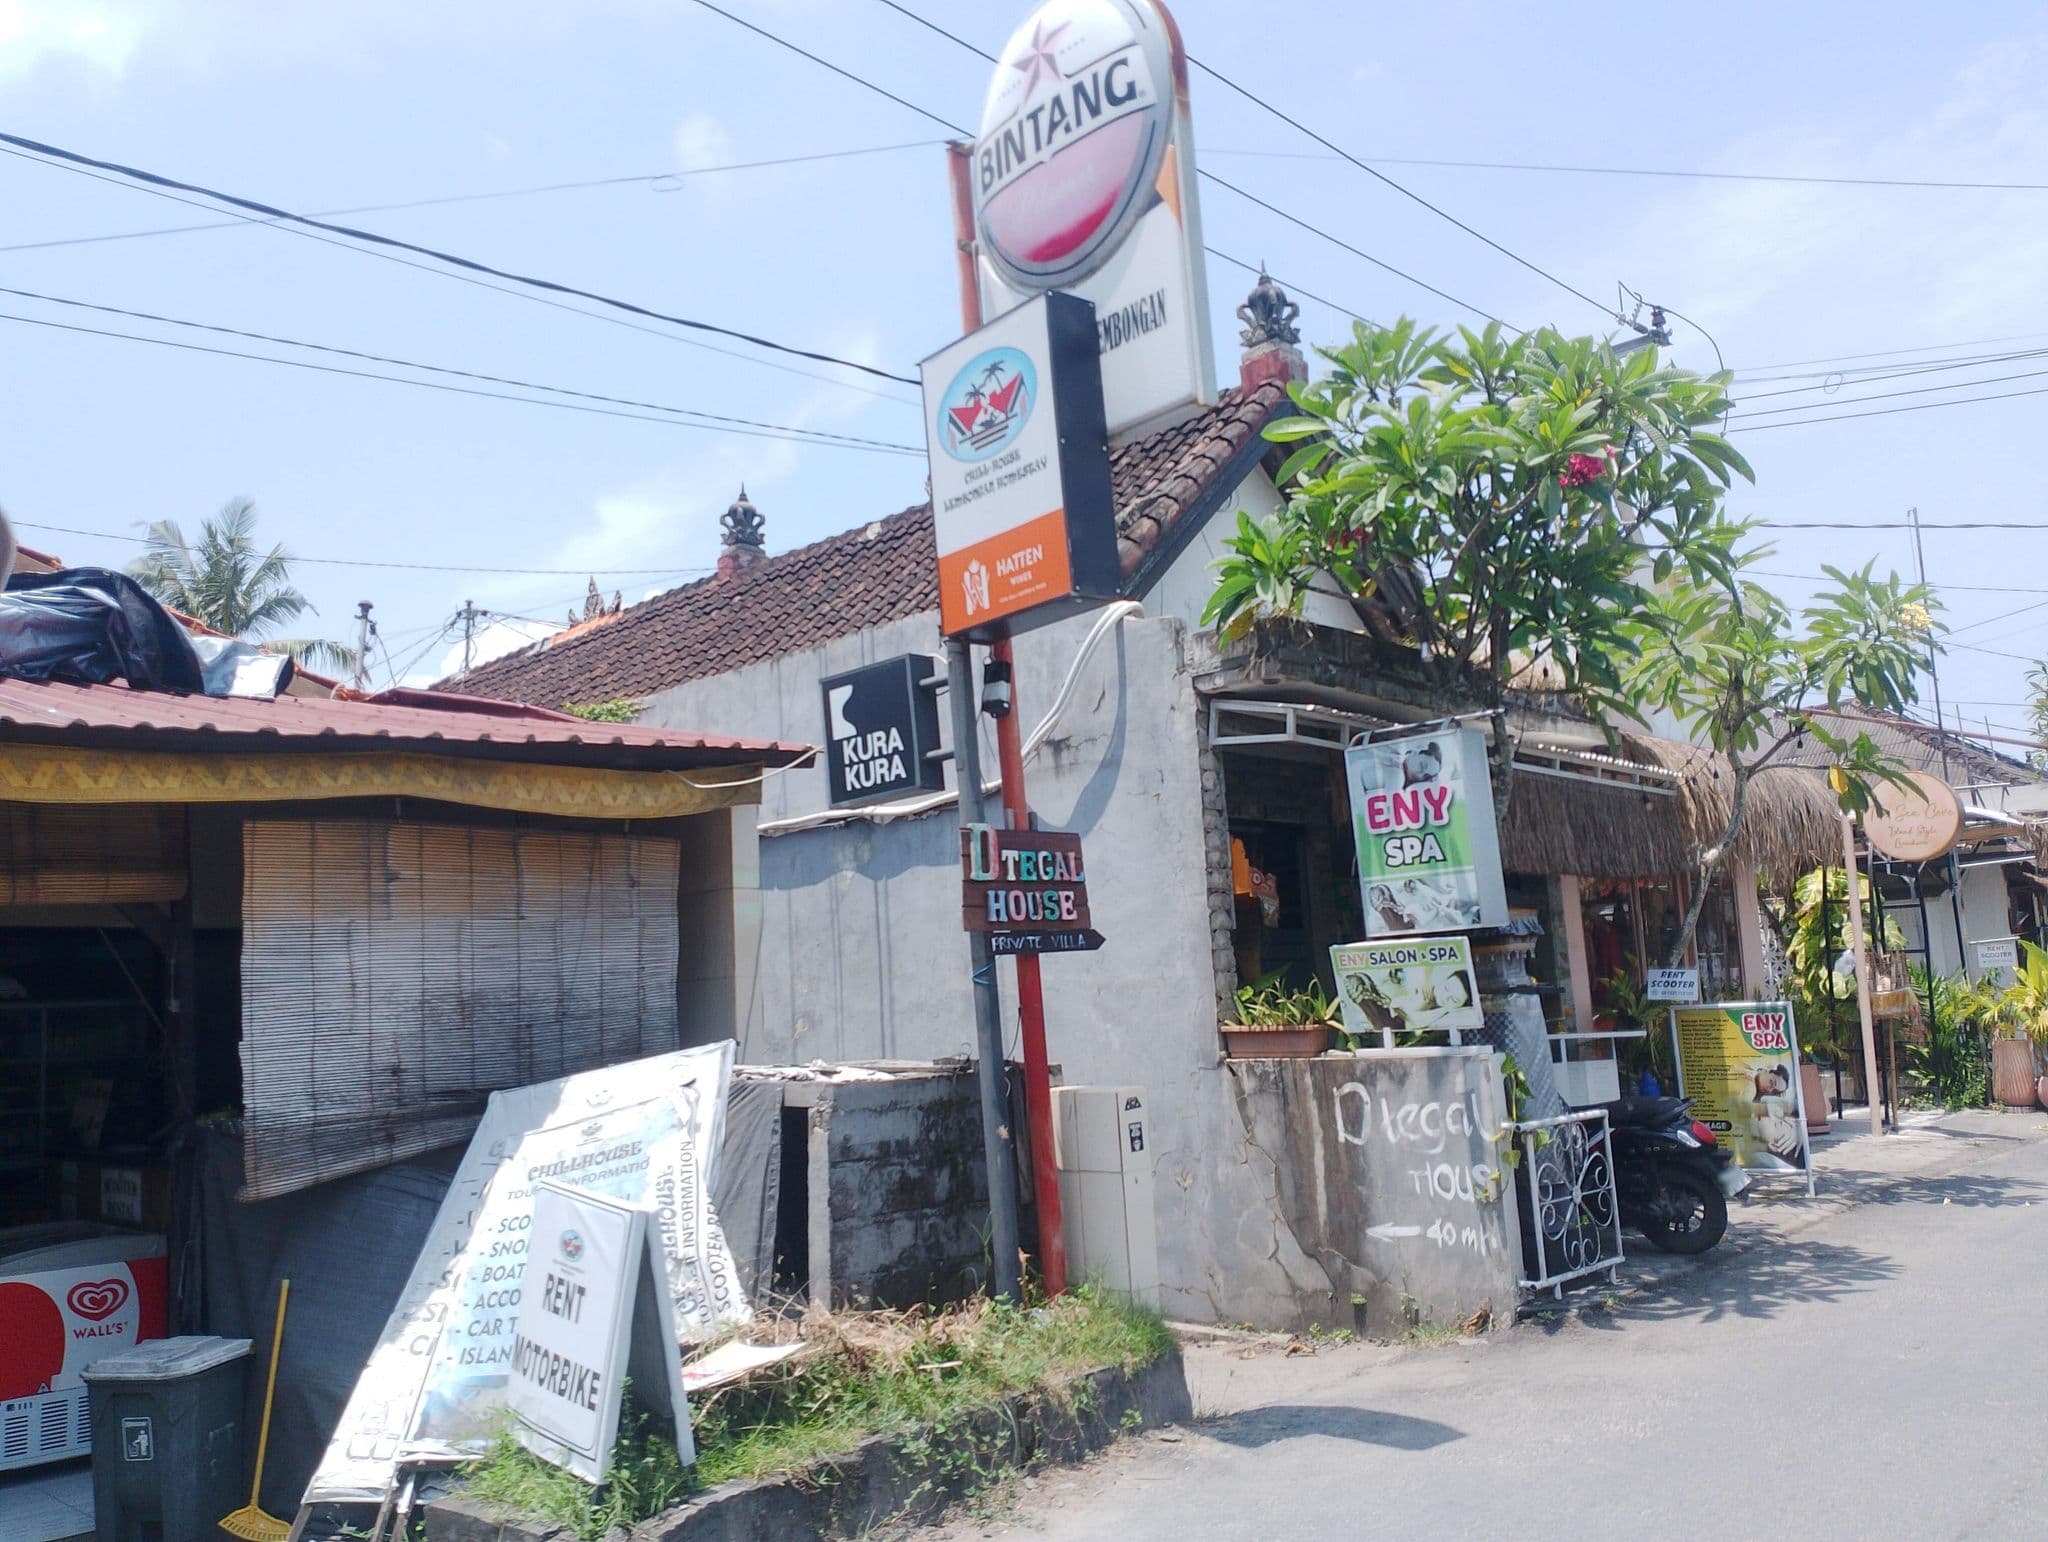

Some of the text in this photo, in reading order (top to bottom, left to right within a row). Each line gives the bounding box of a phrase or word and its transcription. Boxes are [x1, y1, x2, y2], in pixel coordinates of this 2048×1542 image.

[981, 57, 1138, 194] BINTANG
[996, 543, 1043, 577] HATTEN
[843, 727, 904, 765] KURA
[845, 754, 907, 792] KURA
[1366, 785, 1450, 831] ENY
[1384, 833, 1446, 867] SPA
[987, 889, 1078, 922] HOUSE
[1051, 933, 1087, 948] VILLA
[1340, 953, 1366, 968] ENY
[1369, 949, 1417, 965] SALON
[1429, 947, 1459, 961] SPA
[1650, 980, 1695, 989] SCOOTER
[1661, 971, 1686, 980] RENT
[1743, 1013, 1785, 1032] ENY
[1754, 1032, 1787, 1047] SPA
[680, 1140, 695, 1248] INFORMATION
[489, 1238, 529, 1258] SNO
[1426, 1217, 1457, 1249] 40
[481, 1262, 527, 1283] BOAT
[542, 1272, 587, 1325] RENT
[73, 1322, 123, 1339] WALL'S
[467, 1318, 503, 1338] CAR
[512, 1333, 601, 1412] MOTORBIKE
